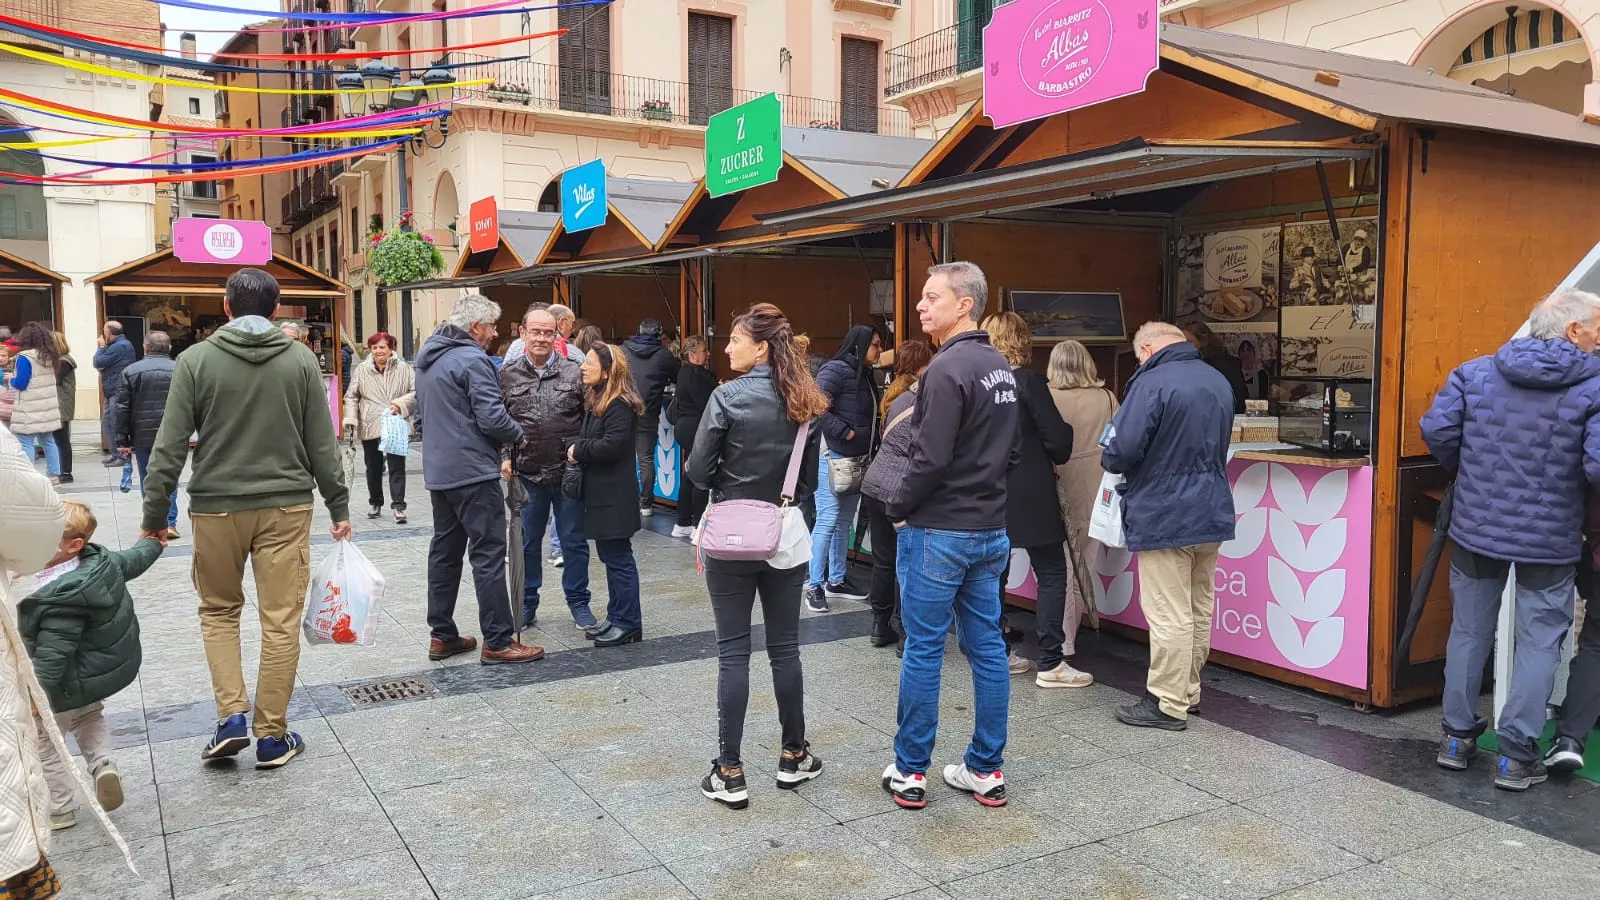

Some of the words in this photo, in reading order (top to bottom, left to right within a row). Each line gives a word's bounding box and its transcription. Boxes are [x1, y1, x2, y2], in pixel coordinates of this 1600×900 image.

[1053, 7, 1094, 30] BIARRITZ
[1038, 67, 1092, 93] BARBASTRO
[736, 112, 746, 145] Z
[720, 145, 764, 175] ZUCRER
[572, 183, 596, 205] Vilas
